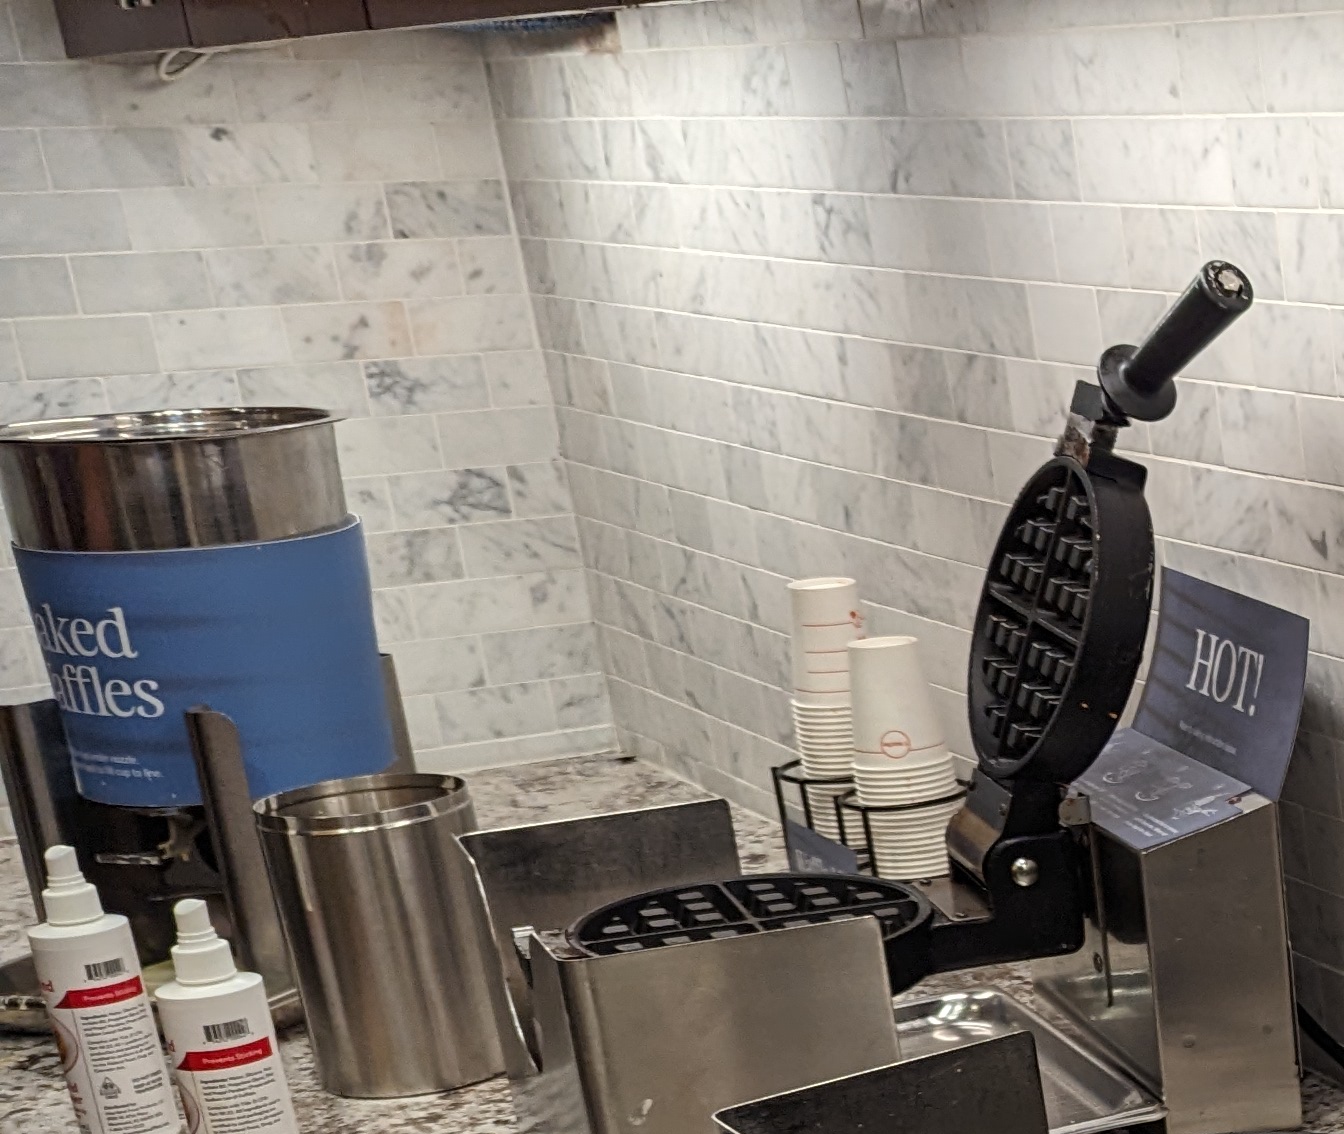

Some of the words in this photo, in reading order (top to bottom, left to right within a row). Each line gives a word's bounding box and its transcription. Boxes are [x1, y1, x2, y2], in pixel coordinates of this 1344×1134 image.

[33, 603, 139, 659] aked
[51, 664, 165, 718] affles
[1186, 628, 1265, 717] HOT!
